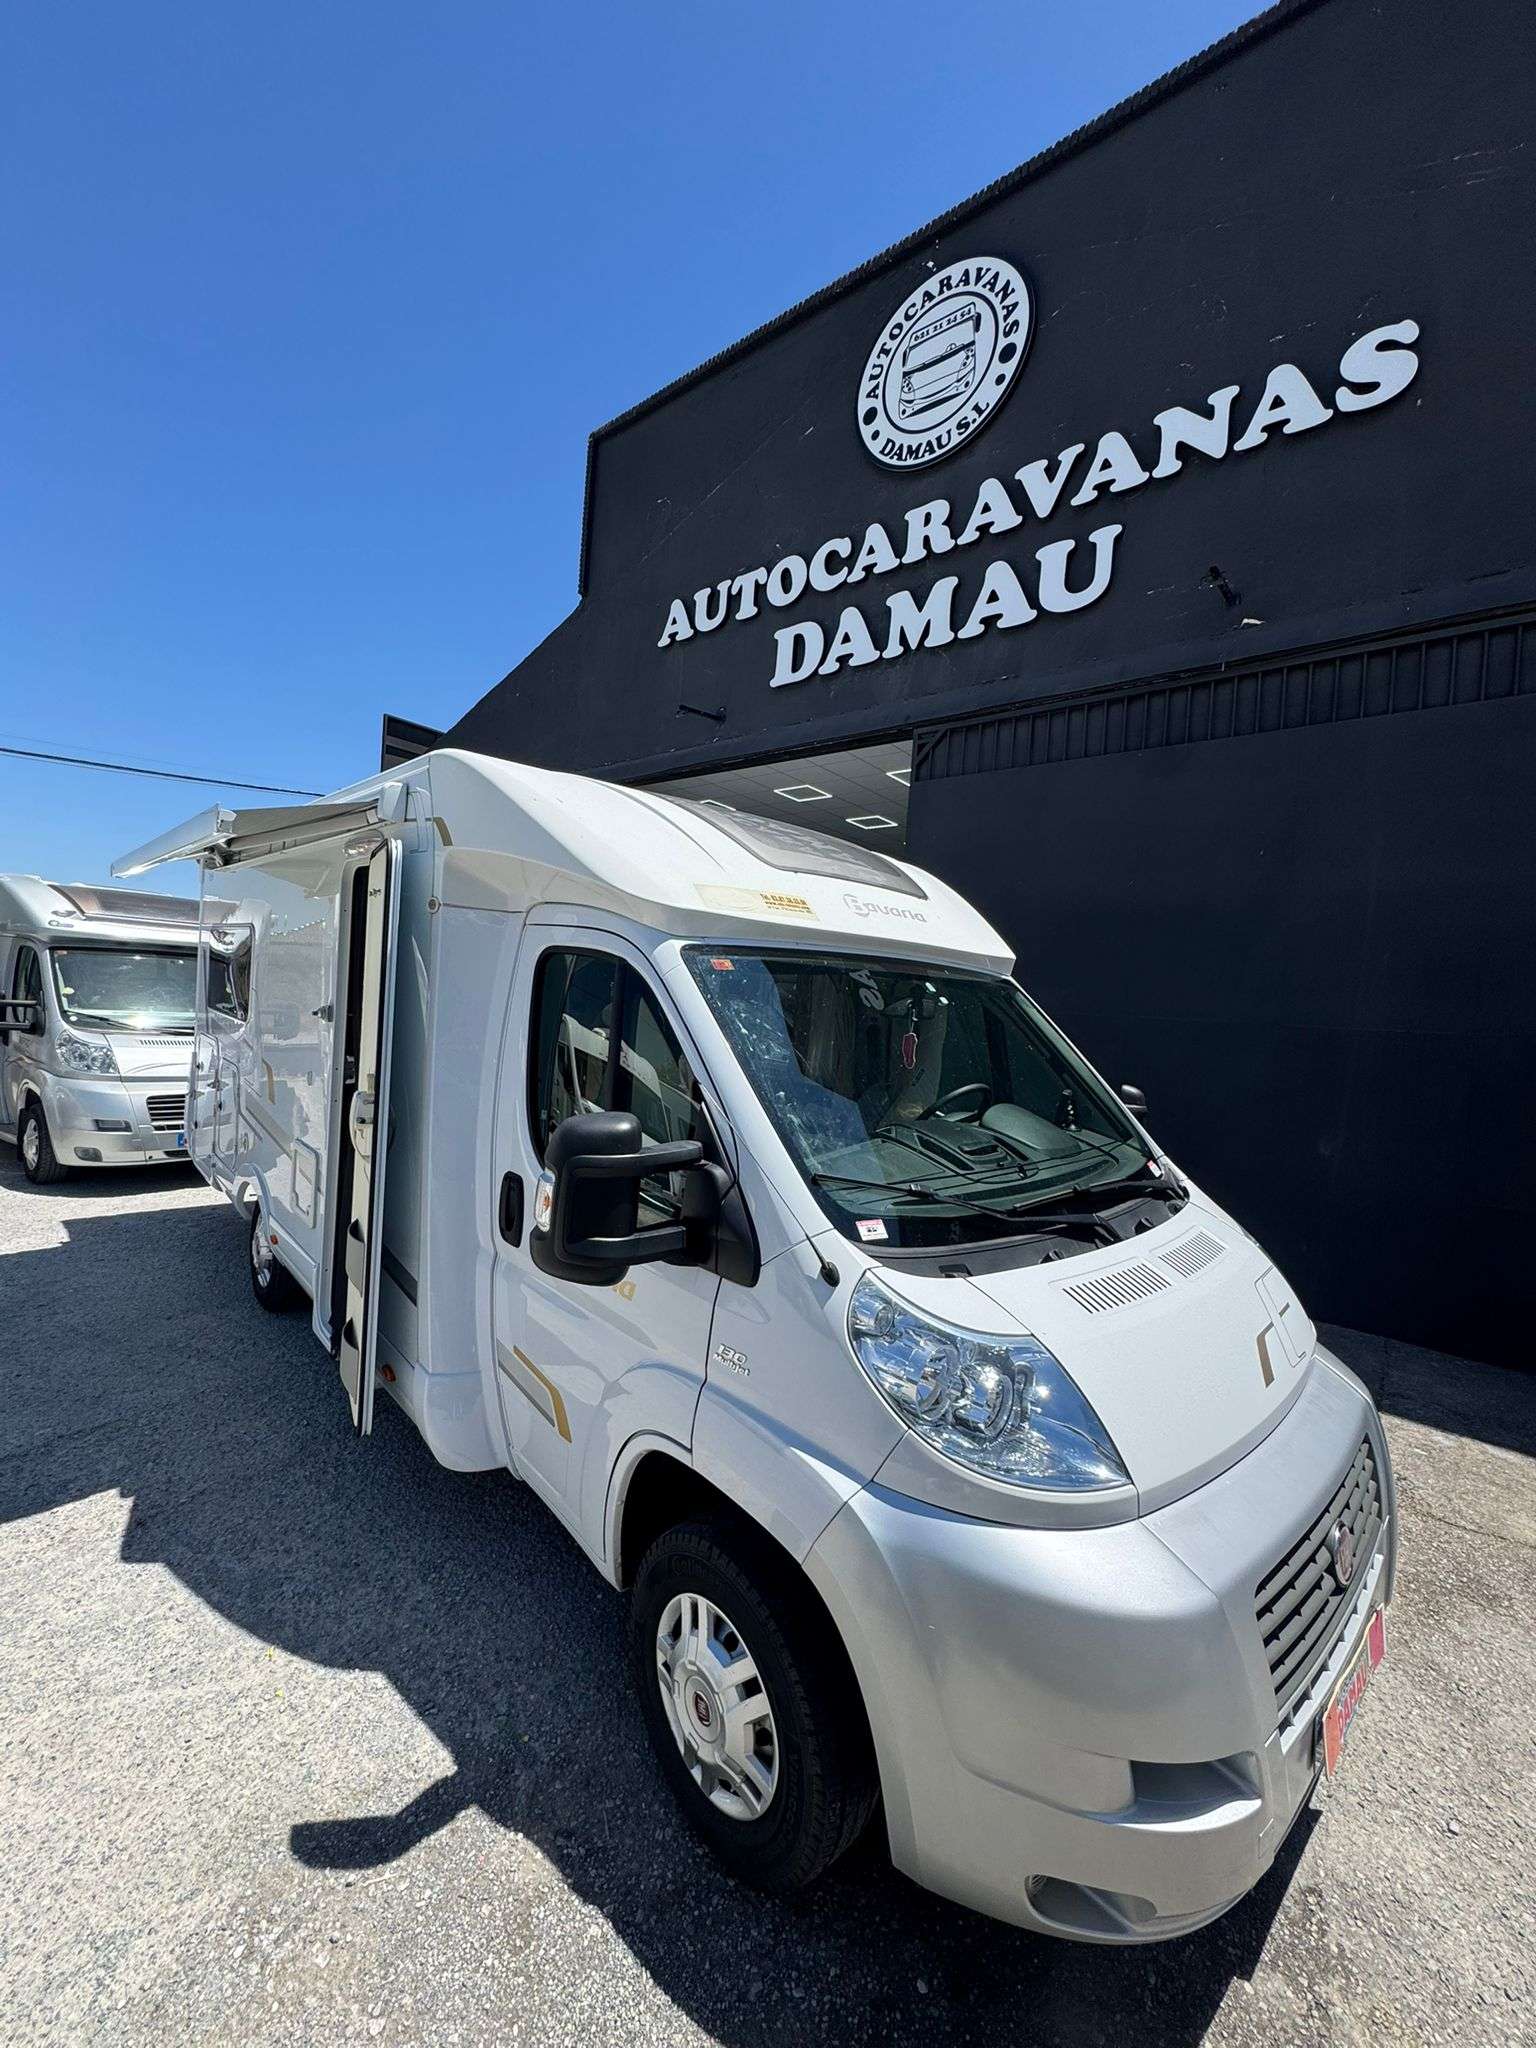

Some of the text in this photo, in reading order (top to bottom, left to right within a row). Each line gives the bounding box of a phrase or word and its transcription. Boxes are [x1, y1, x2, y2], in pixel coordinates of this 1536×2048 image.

[866, 267, 1020, 399] AUTOCARAVANAS
[914, 329, 930, 342] 621
[932, 322, 943, 333] 21
[879, 401, 990, 461] DAMAU S.L
[657, 319, 1420, 648] AUTOCARAVANAS
[770, 524, 1123, 688] DAMAU
[719, 1343, 748, 1365] 130
